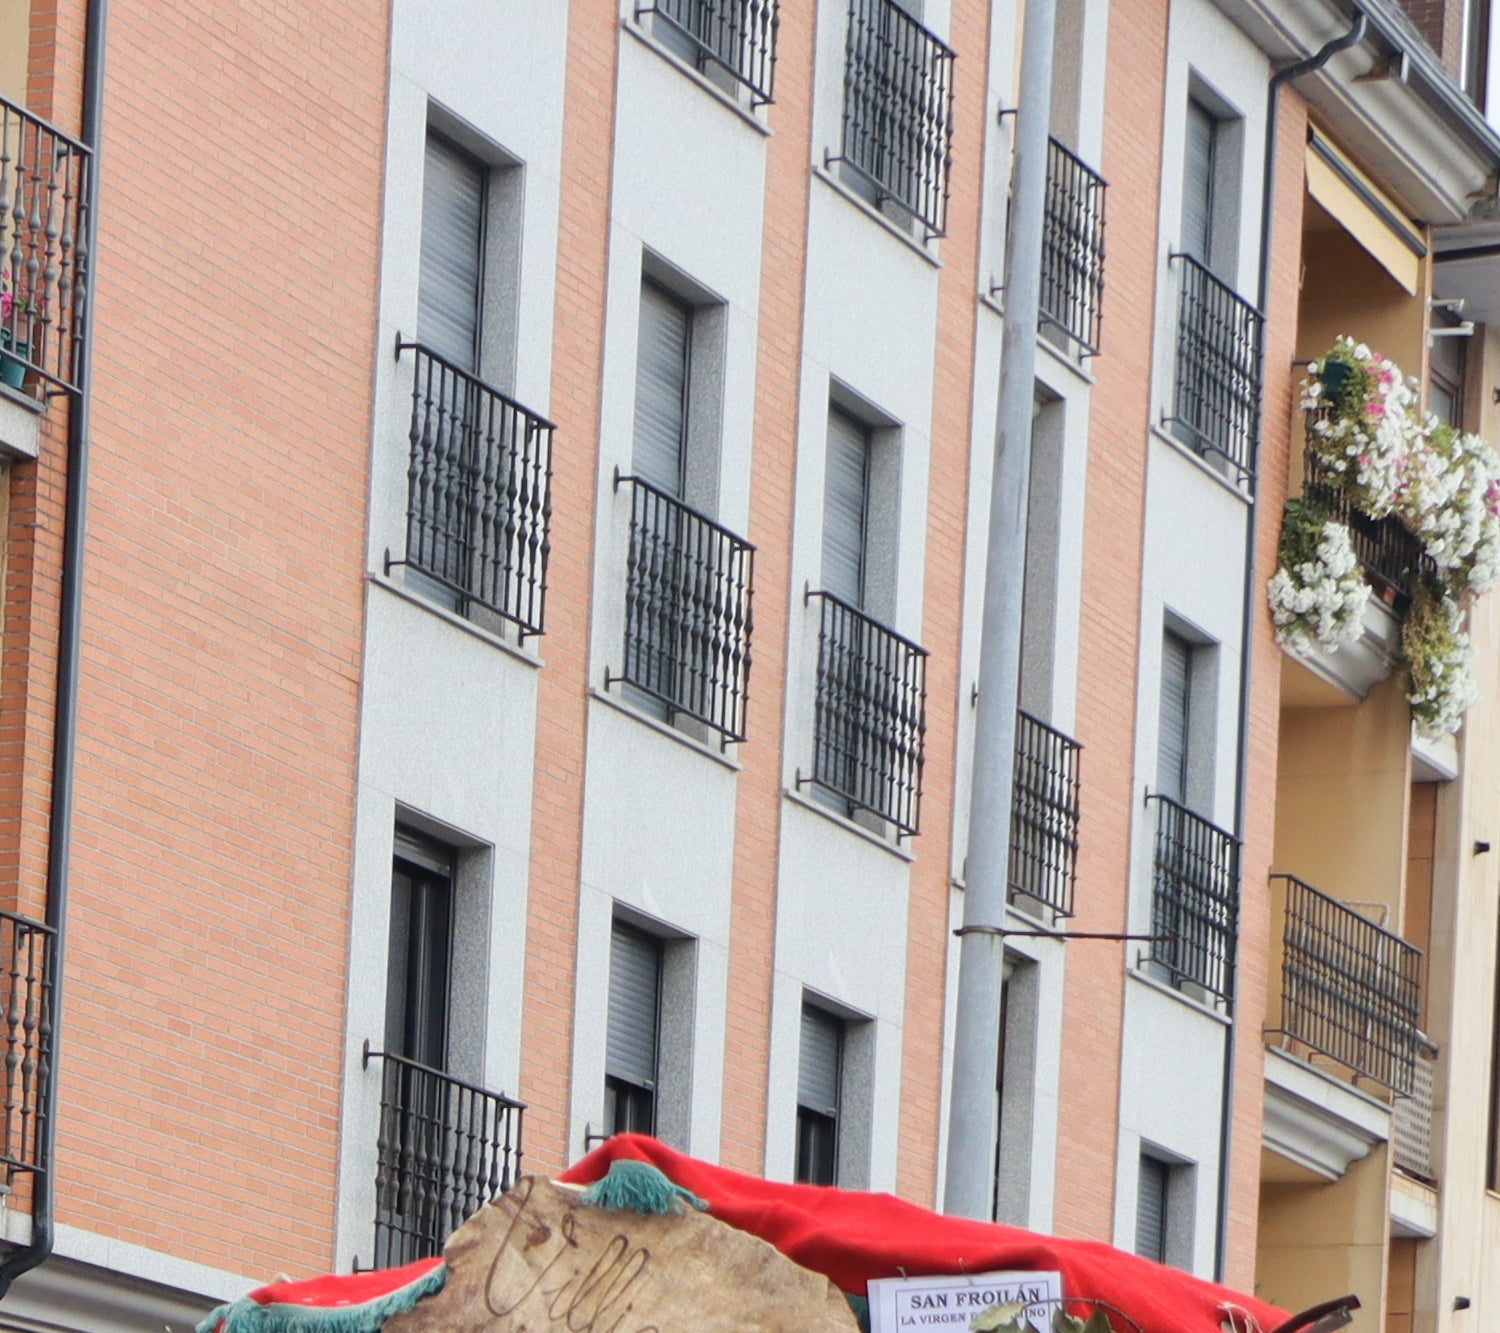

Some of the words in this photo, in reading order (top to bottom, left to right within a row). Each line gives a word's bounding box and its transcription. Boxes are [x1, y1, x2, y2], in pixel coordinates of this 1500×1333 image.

[910, 1293, 948, 1310] SAN
[956, 1283, 1041, 1306] FROILÁN
[900, 1316, 916, 1326] LA
[919, 1312, 966, 1325] VIRGEN
